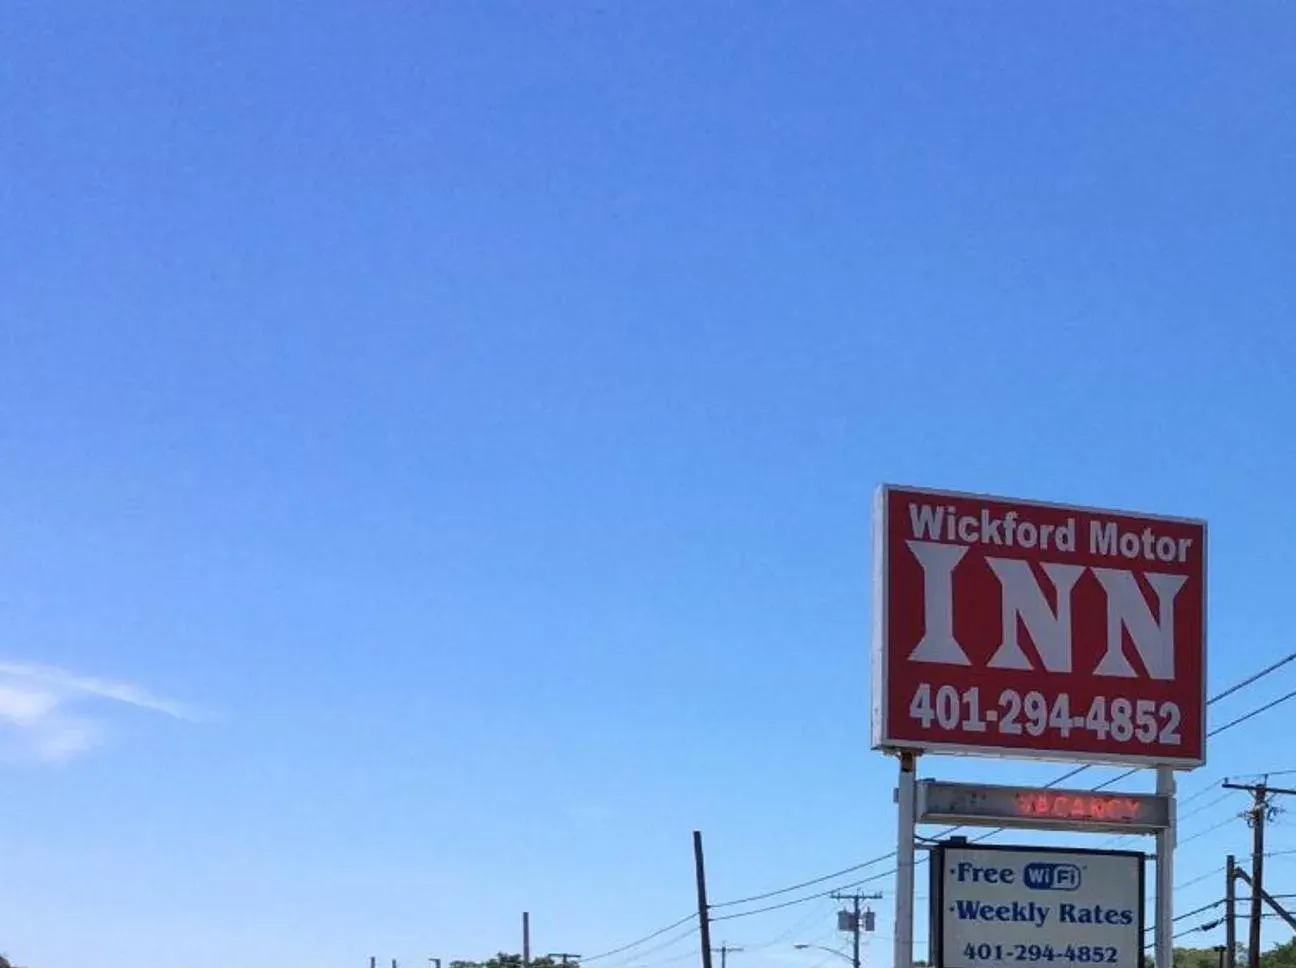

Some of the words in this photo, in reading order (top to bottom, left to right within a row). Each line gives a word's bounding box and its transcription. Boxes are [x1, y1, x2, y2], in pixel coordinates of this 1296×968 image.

[908, 503, 1076, 552] Wickford
[1089, 520, 1193, 562] Motor
[905, 539, 1189, 680] INN
[909, 683, 1181, 745] 401-294-4852
[1018, 793, 1140, 818] VACANCY
[957, 862, 1016, 884] Free
[956, 900, 1050, 928] Weekly
[1059, 902, 1133, 926] Rates
[963, 943, 1119, 964] 401-294-4852
